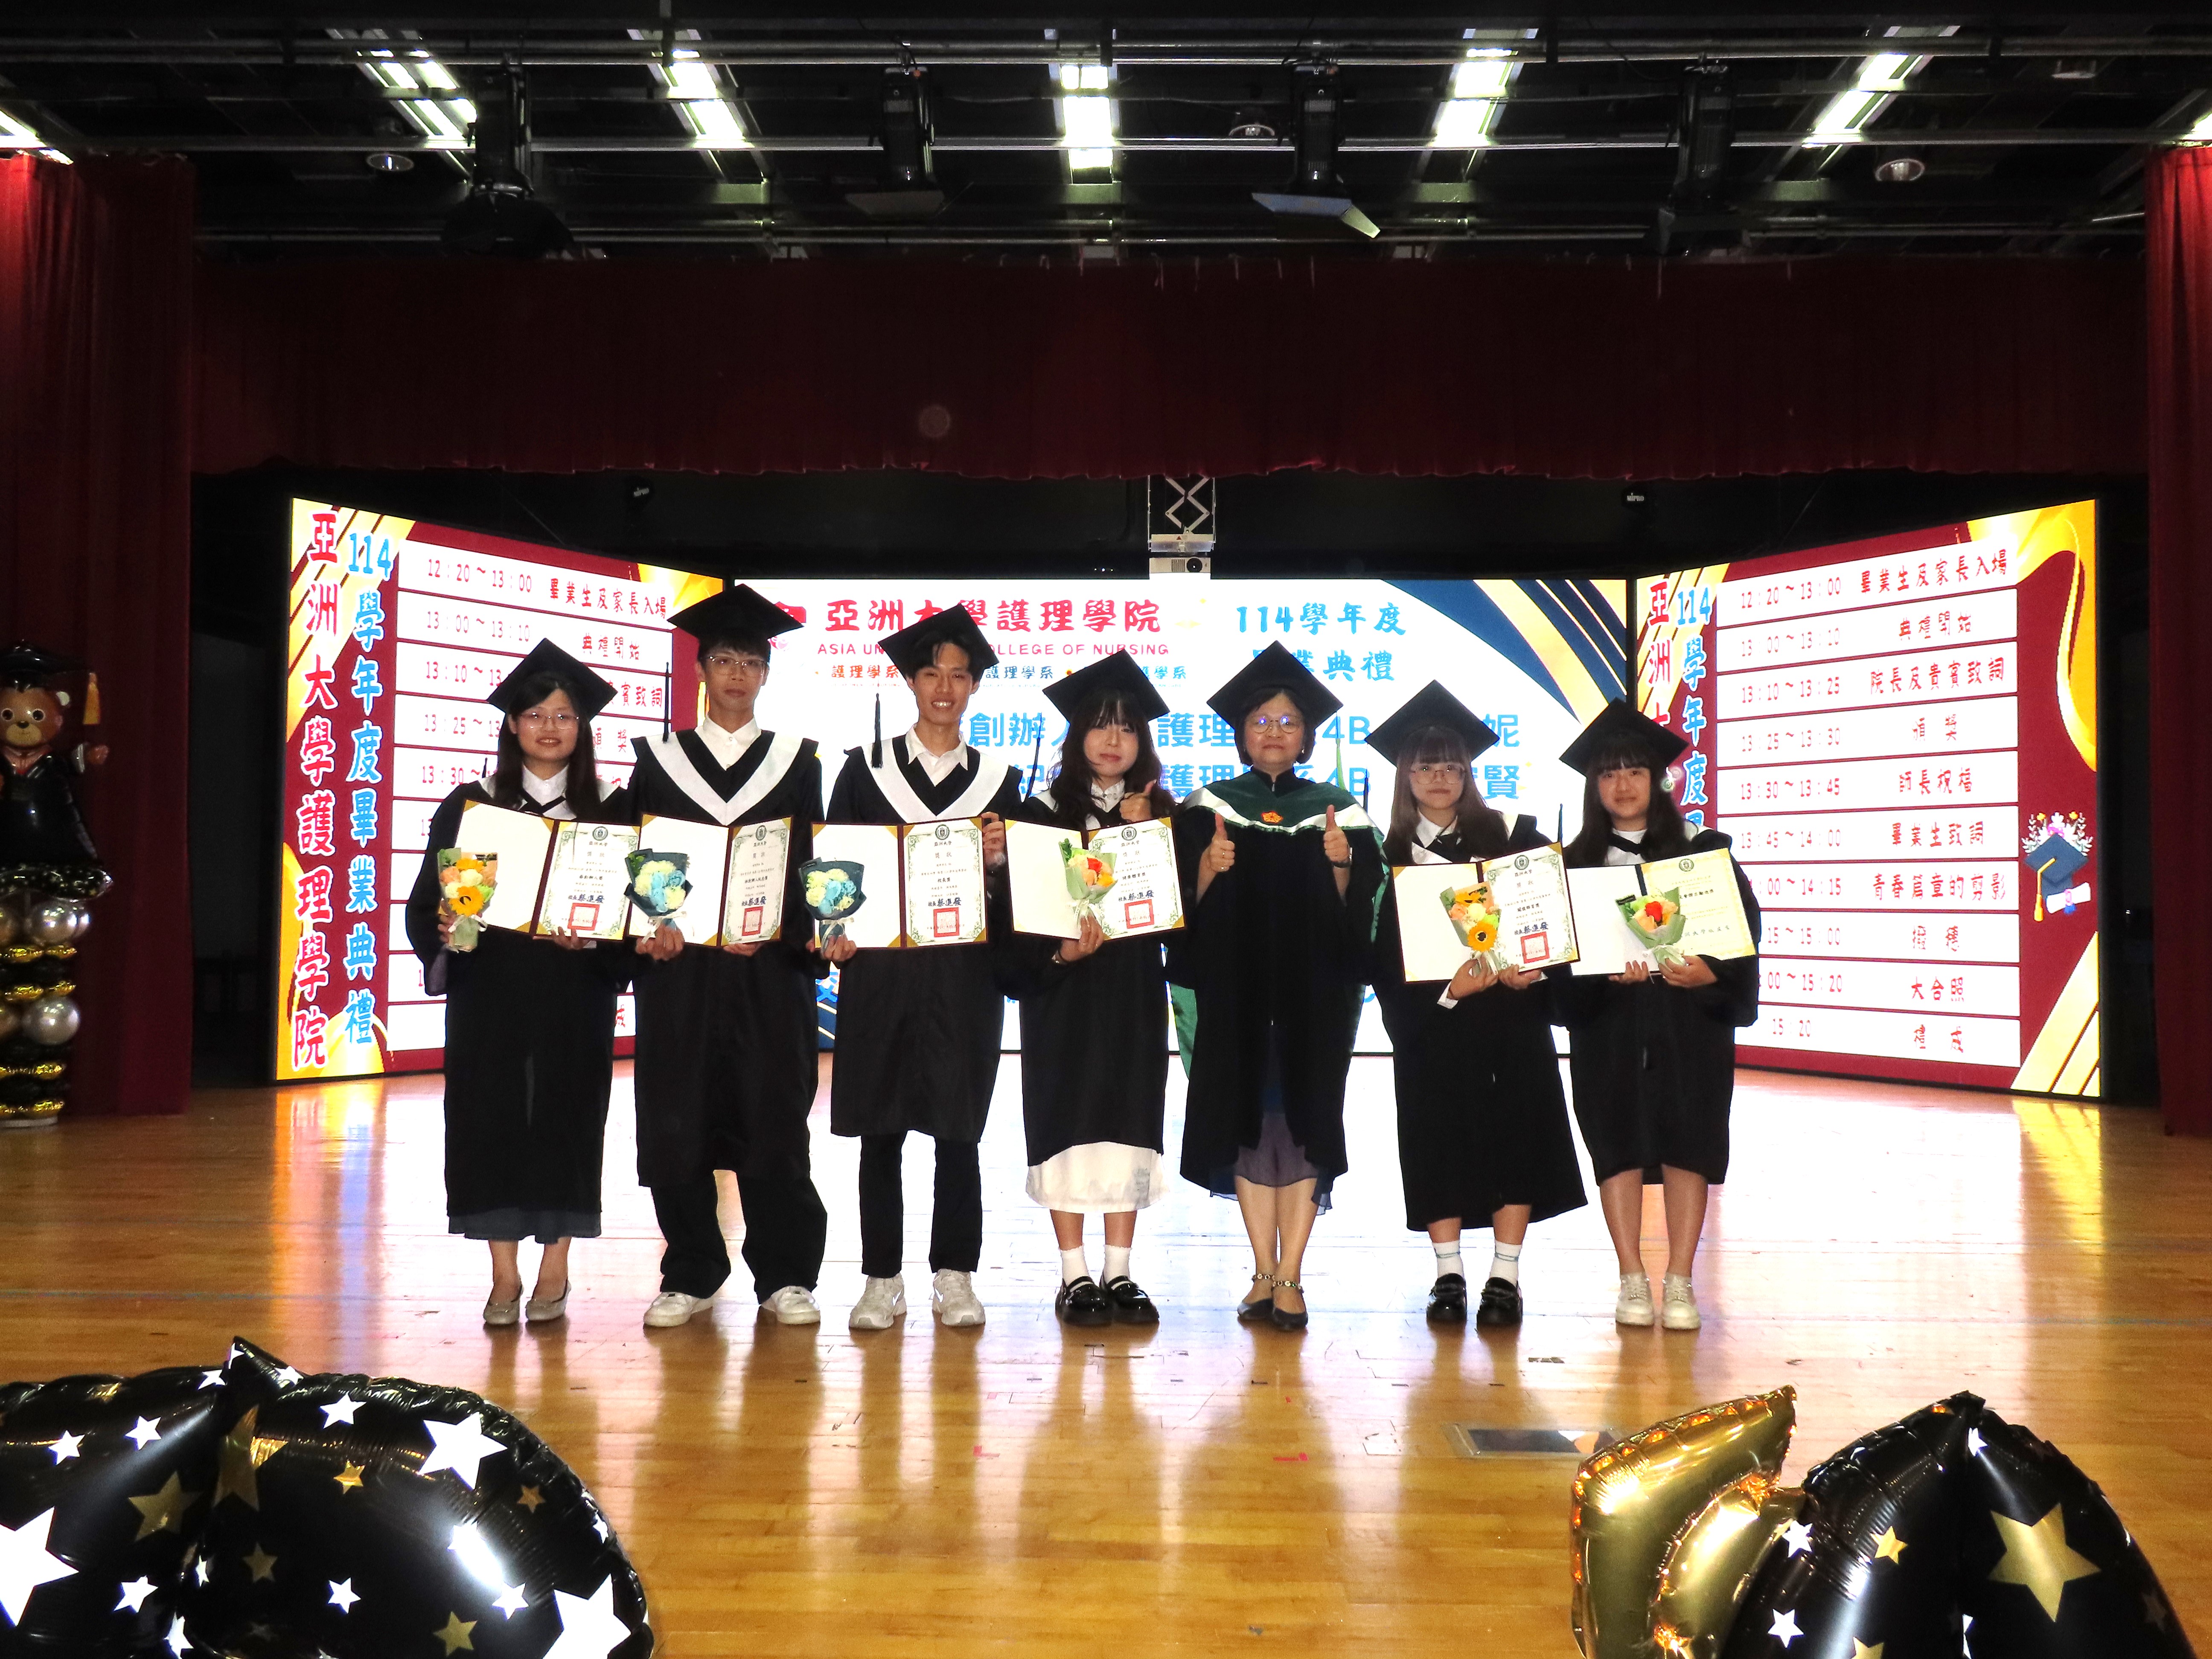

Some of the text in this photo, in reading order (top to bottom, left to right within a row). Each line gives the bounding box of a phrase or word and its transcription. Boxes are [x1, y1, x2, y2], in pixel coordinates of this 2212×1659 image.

[1861, 549, 2006, 593] 畢業生及家長入場
[550, 578, 666, 619] 畢業生及家長入場
[818, 643, 856, 655] ASIA
[1062, 644, 1085, 655] OF
[1093, 644, 1169, 655] NURSING
[831, 664, 899, 679] 護理學系
[1253, 649, 1395, 682] 業典禮
[1871, 657, 2004, 693] 院長及貴賓致詞
[608, 680, 662, 707] 賓致詞
[293, 512, 338, 1069] 亞洲大學護理學院
[345, 533, 393, 1044] 114學年度畢業典禮
[1899, 768, 1972, 795] 師長祝福
[1892, 821, 1983, 847] 畢業生致詞
[1873, 873, 2005, 900] 青春篇章的剪影
[1911, 977, 1964, 1001] 大合照
